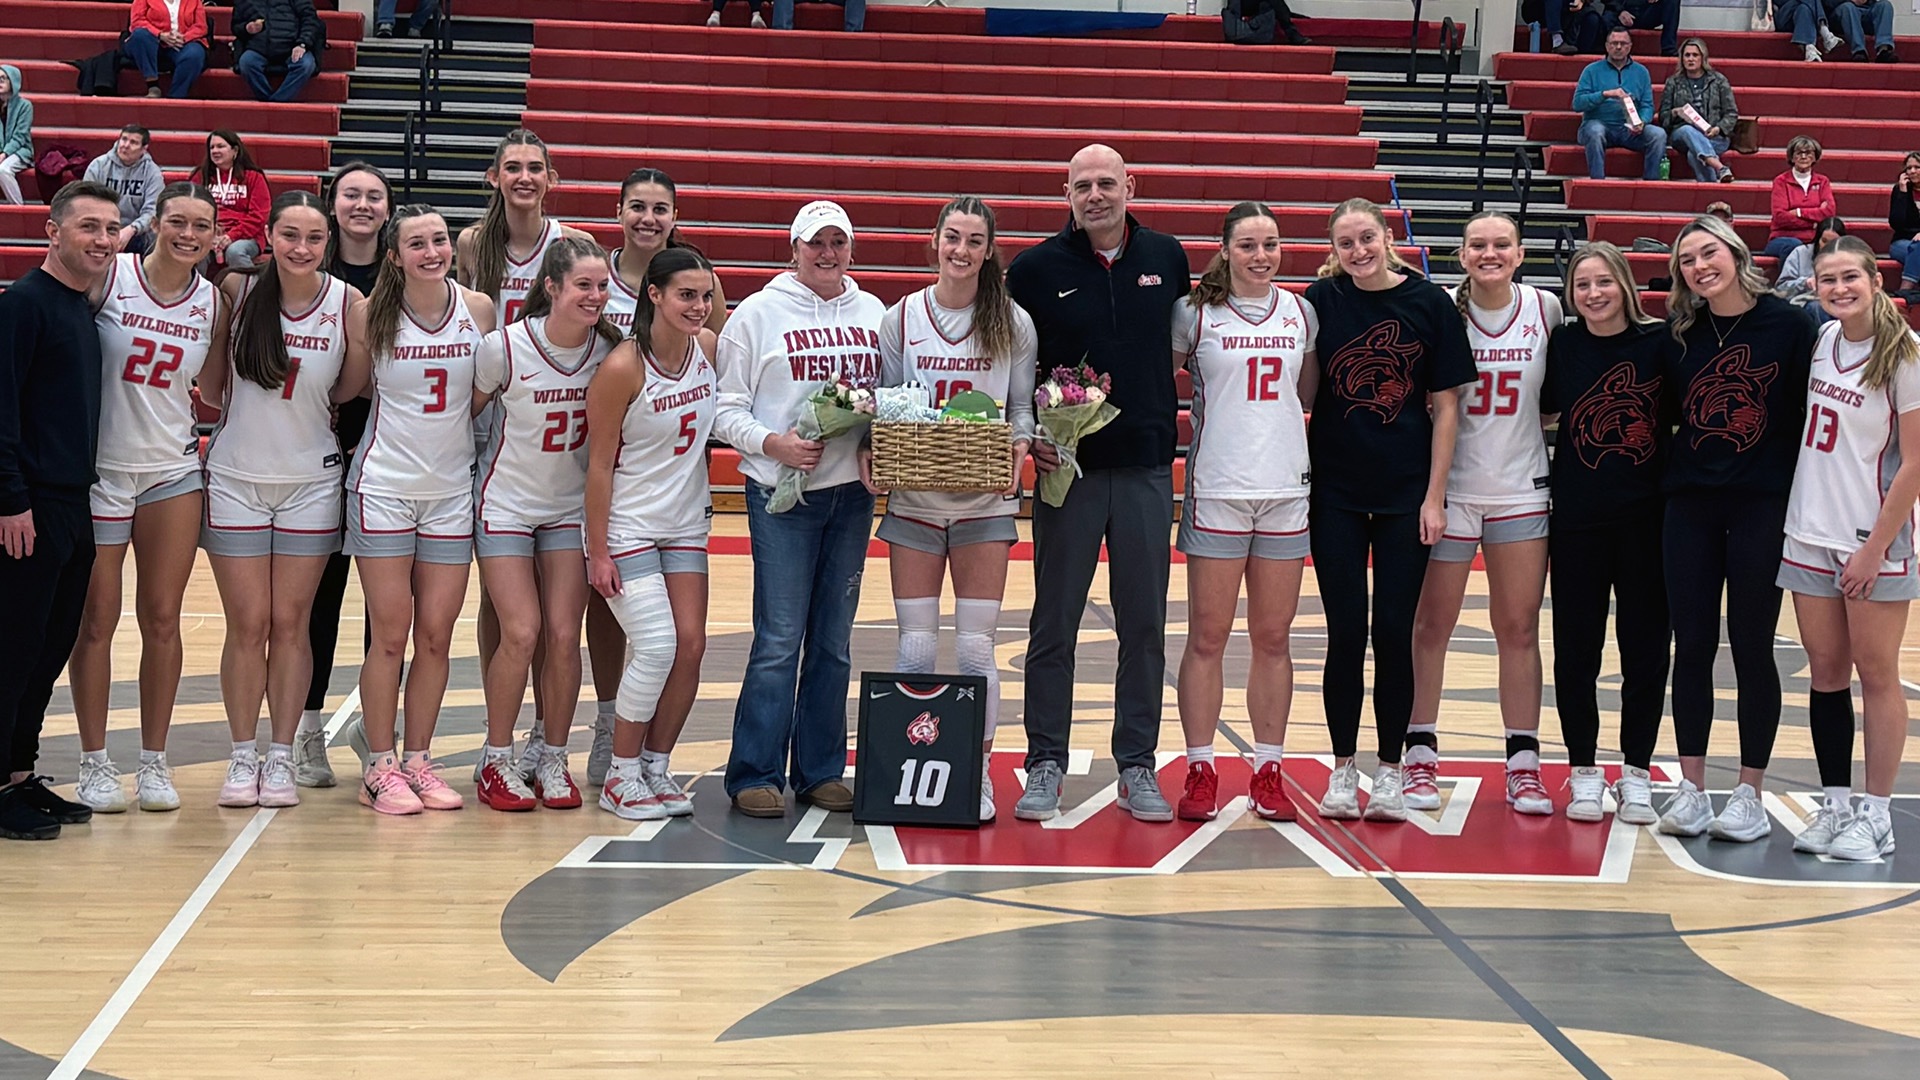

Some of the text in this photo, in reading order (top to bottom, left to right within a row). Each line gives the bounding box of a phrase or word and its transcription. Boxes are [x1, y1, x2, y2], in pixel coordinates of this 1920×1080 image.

[121, 312, 200, 342] WILDCATS
[284, 332, 330, 352] DCATS
[783, 326, 879, 354] INDIANA
[394, 342, 472, 360] WILDCATS
[1222, 336, 1296, 350] WILDCATS
[1472, 348, 1533, 362] ILDCATS
[122, 336, 185, 390] 22
[917, 356, 993, 372] WILDCATS
[1246, 356, 1283, 401] 12
[422, 368, 449, 414] 3
[652, 383, 711, 414] WILDCATS
[1466, 370, 1522, 416] 35
[1809, 377, 1866, 408] WILDCATS
[541, 409, 589, 452] 23
[673, 410, 698, 456] 5
[1805, 402, 1839, 454] 13
[893, 758, 952, 807] 10
